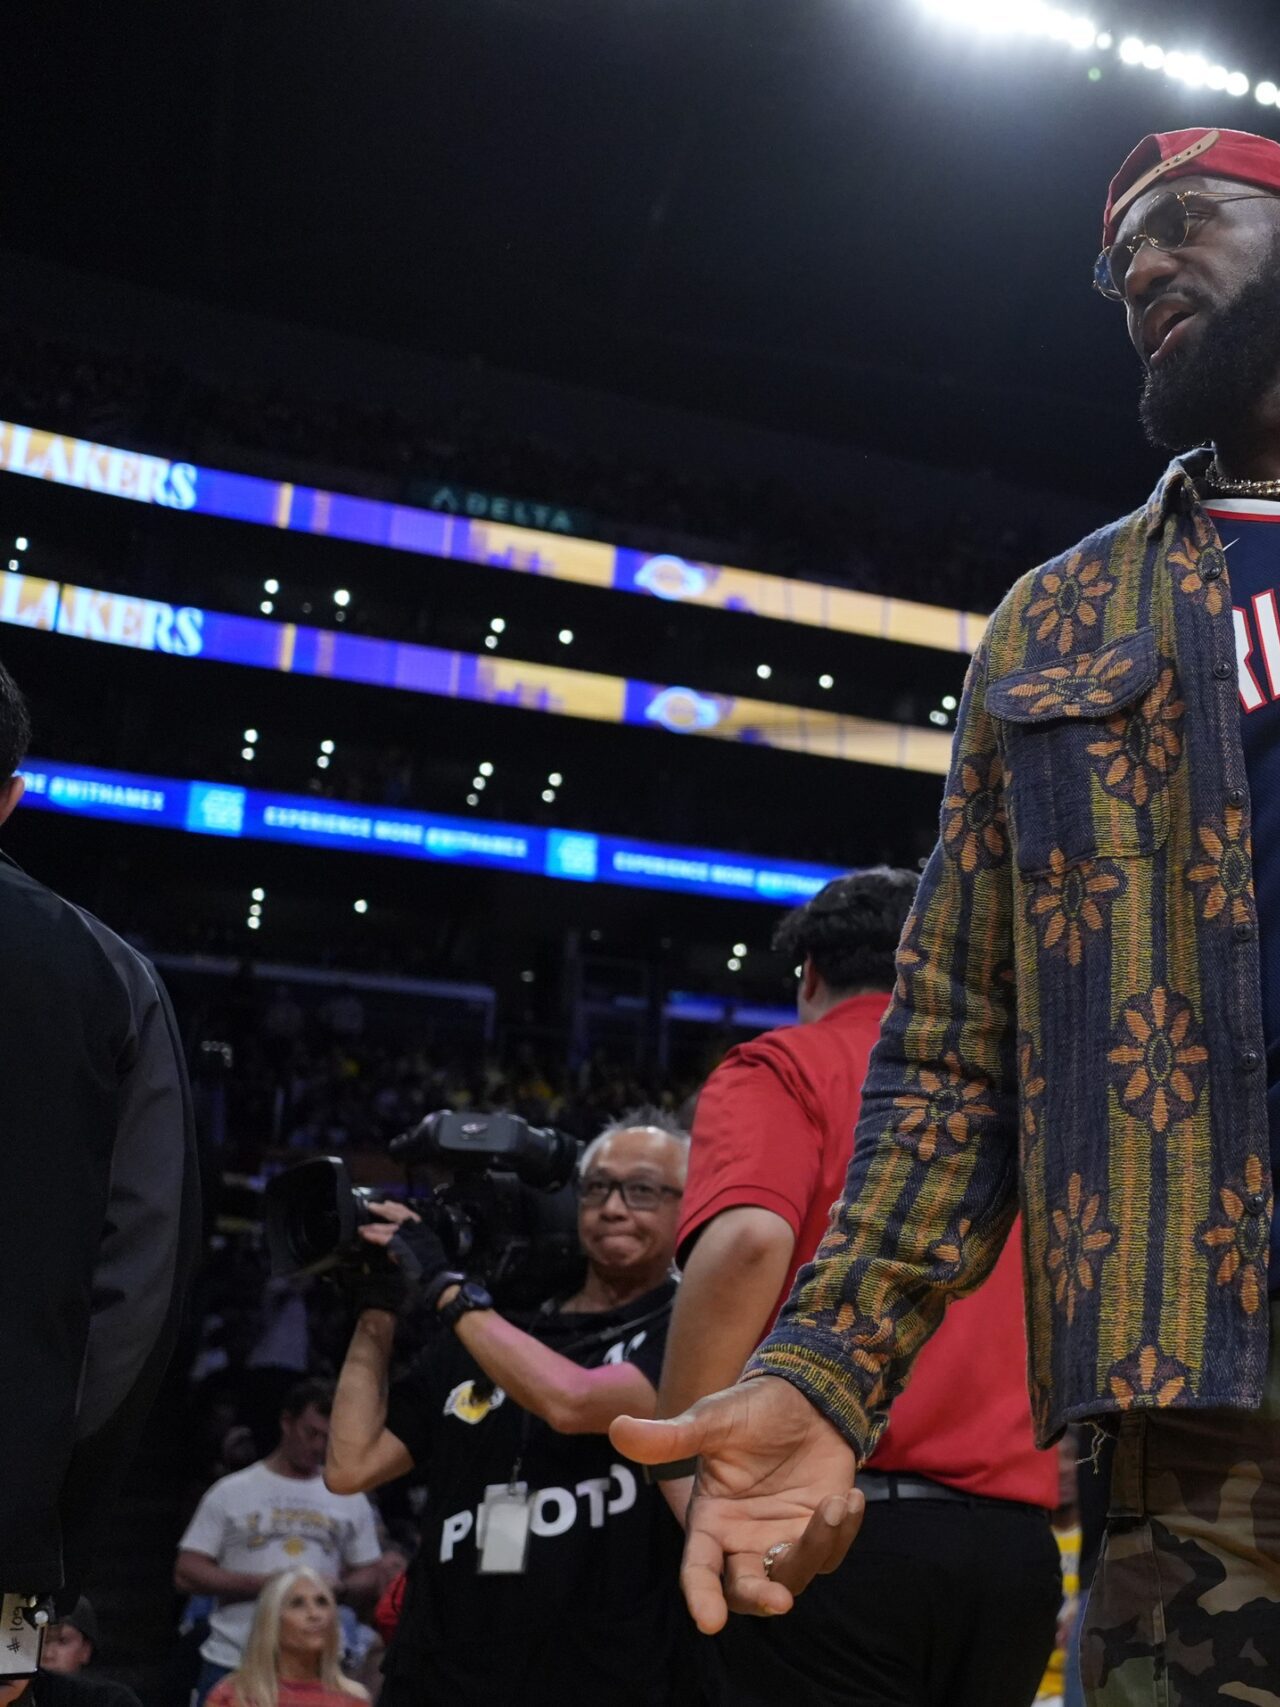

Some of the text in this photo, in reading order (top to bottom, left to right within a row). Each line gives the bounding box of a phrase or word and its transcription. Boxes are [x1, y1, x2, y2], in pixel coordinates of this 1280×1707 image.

[8, 424, 198, 510] LAKERS
[465, 493, 572, 531] DELTA
[1, 570, 204, 657] LAKERS
[264, 806, 371, 838] EXPERIENCE
[373, 820, 423, 845] MORE
